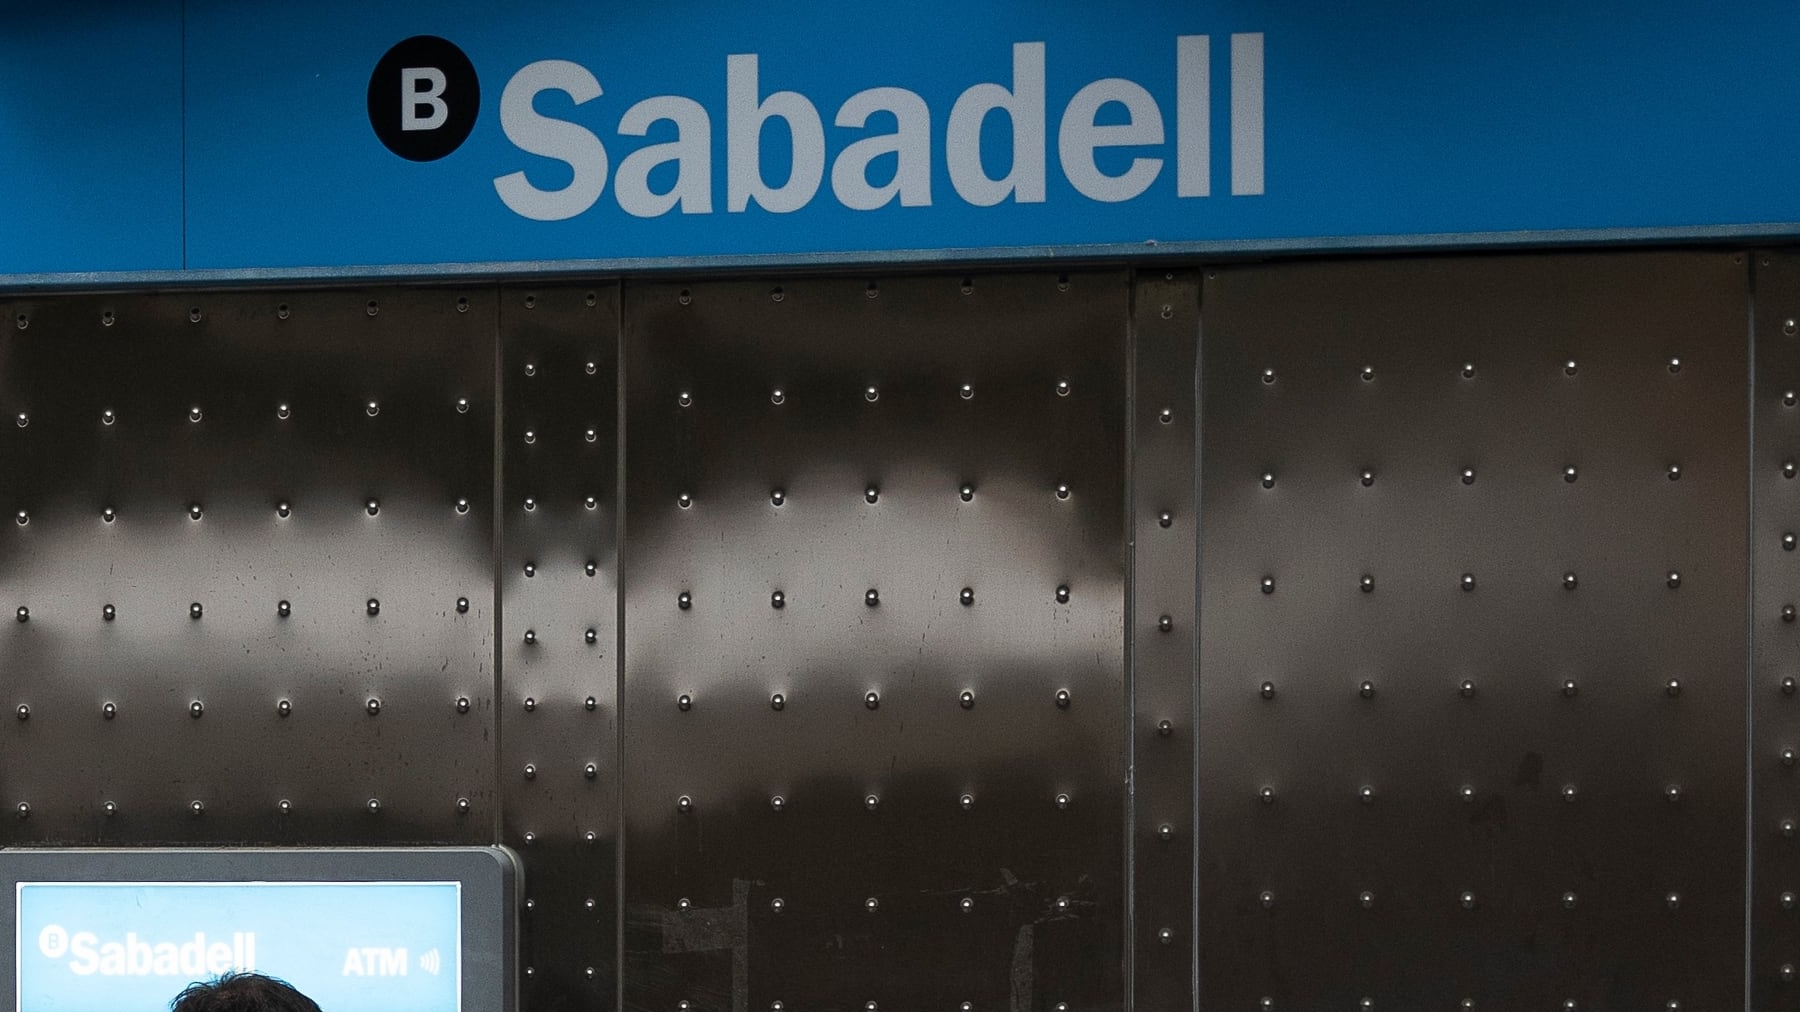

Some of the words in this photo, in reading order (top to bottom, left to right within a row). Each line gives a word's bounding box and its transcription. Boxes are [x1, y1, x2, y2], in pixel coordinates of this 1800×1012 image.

[492, 32, 1265, 221] Sabadell
[69, 932, 255, 976] Sabadell
[342, 948, 407, 976] ATM
